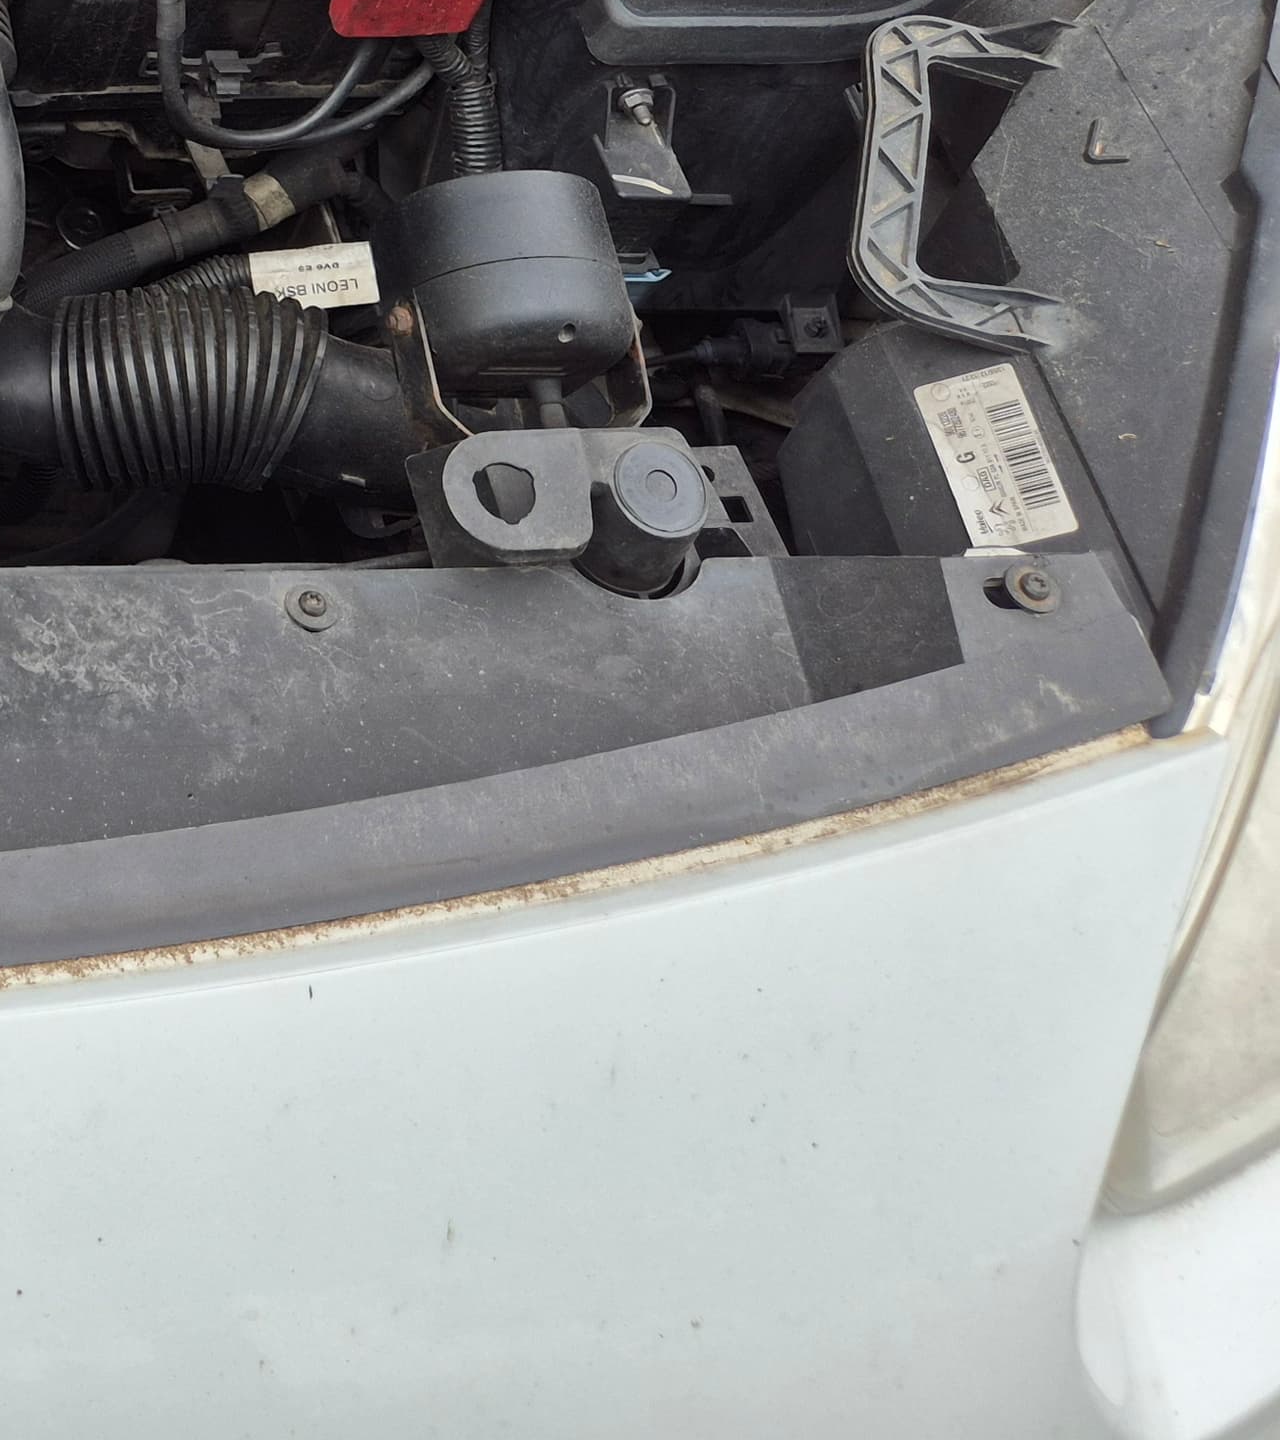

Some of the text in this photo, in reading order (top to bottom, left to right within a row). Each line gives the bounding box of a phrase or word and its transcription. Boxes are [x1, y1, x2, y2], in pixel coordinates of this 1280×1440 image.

[274, 277, 358, 299] LEONI BSK
[956, 450, 975, 464] G
